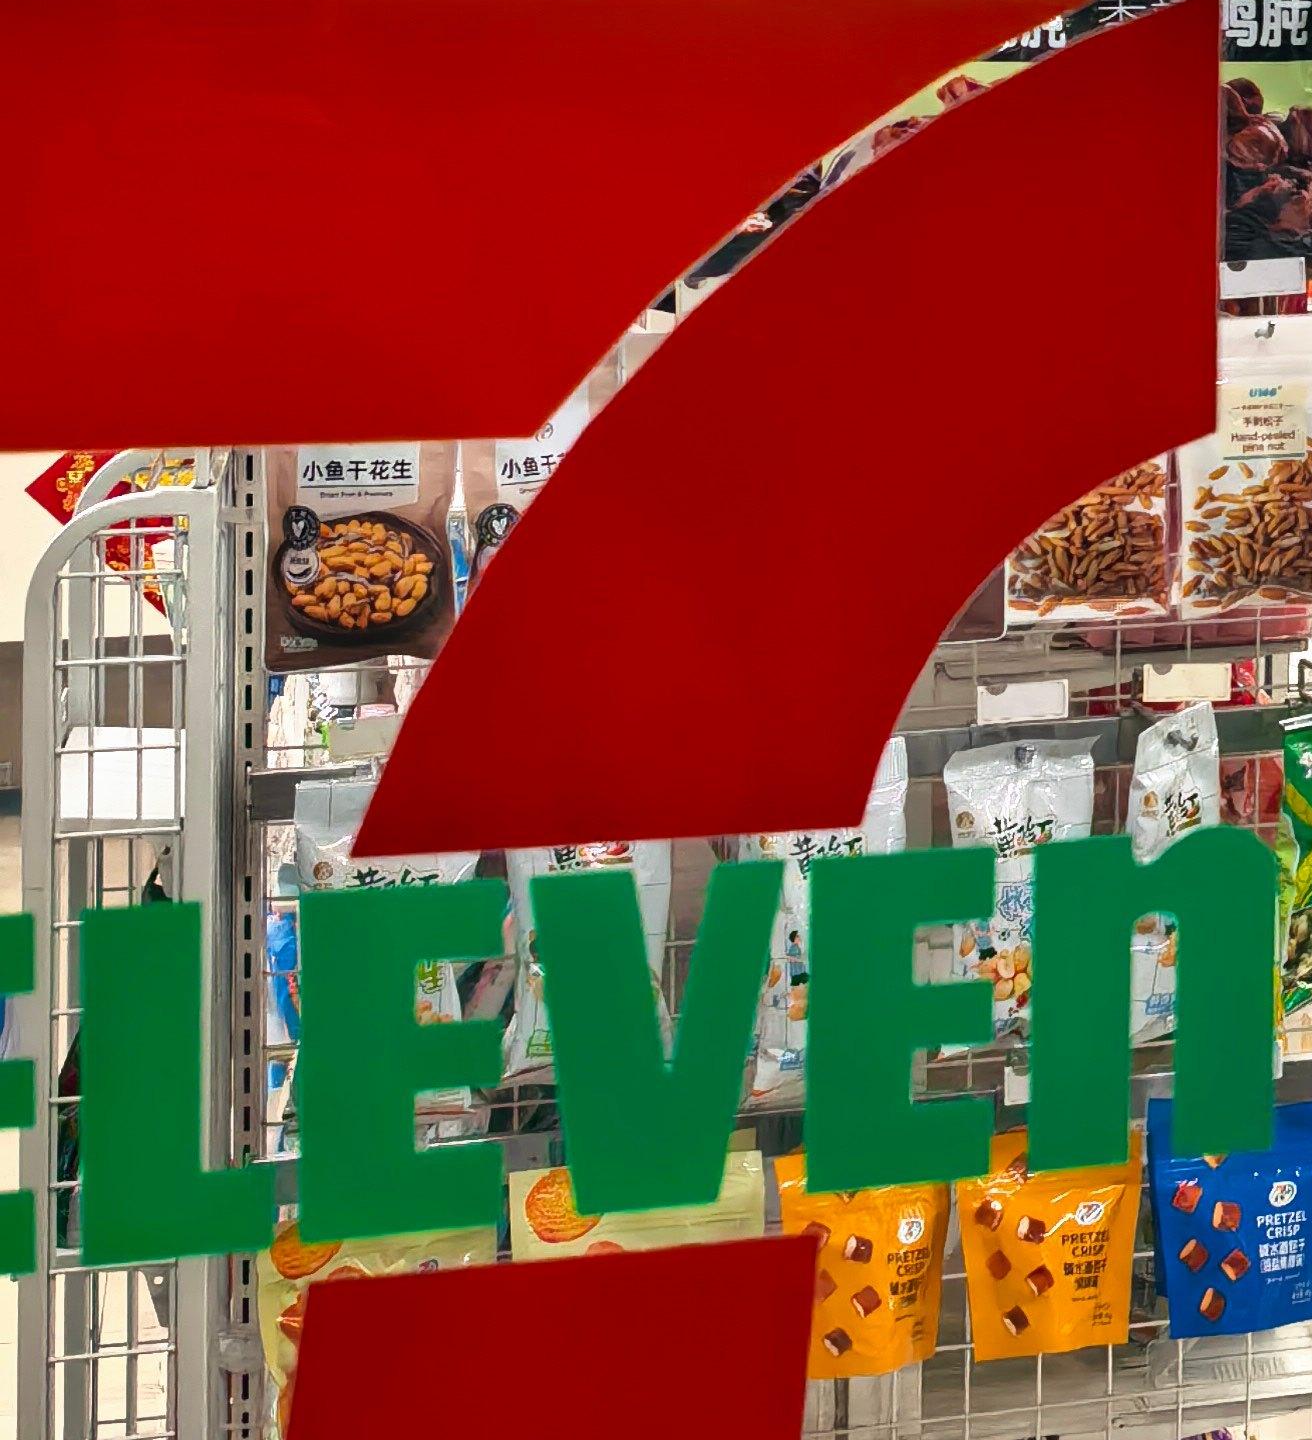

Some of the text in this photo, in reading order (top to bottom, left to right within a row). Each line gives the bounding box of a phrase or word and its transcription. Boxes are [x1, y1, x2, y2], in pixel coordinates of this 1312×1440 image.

[302, 459, 414, 482] 小鱼干花生
[0, 822, 1280, 1276] LEVEn
[1255, 1211, 1308, 1229] PRETZEL
[1266, 1226, 1301, 1240] CRISP
